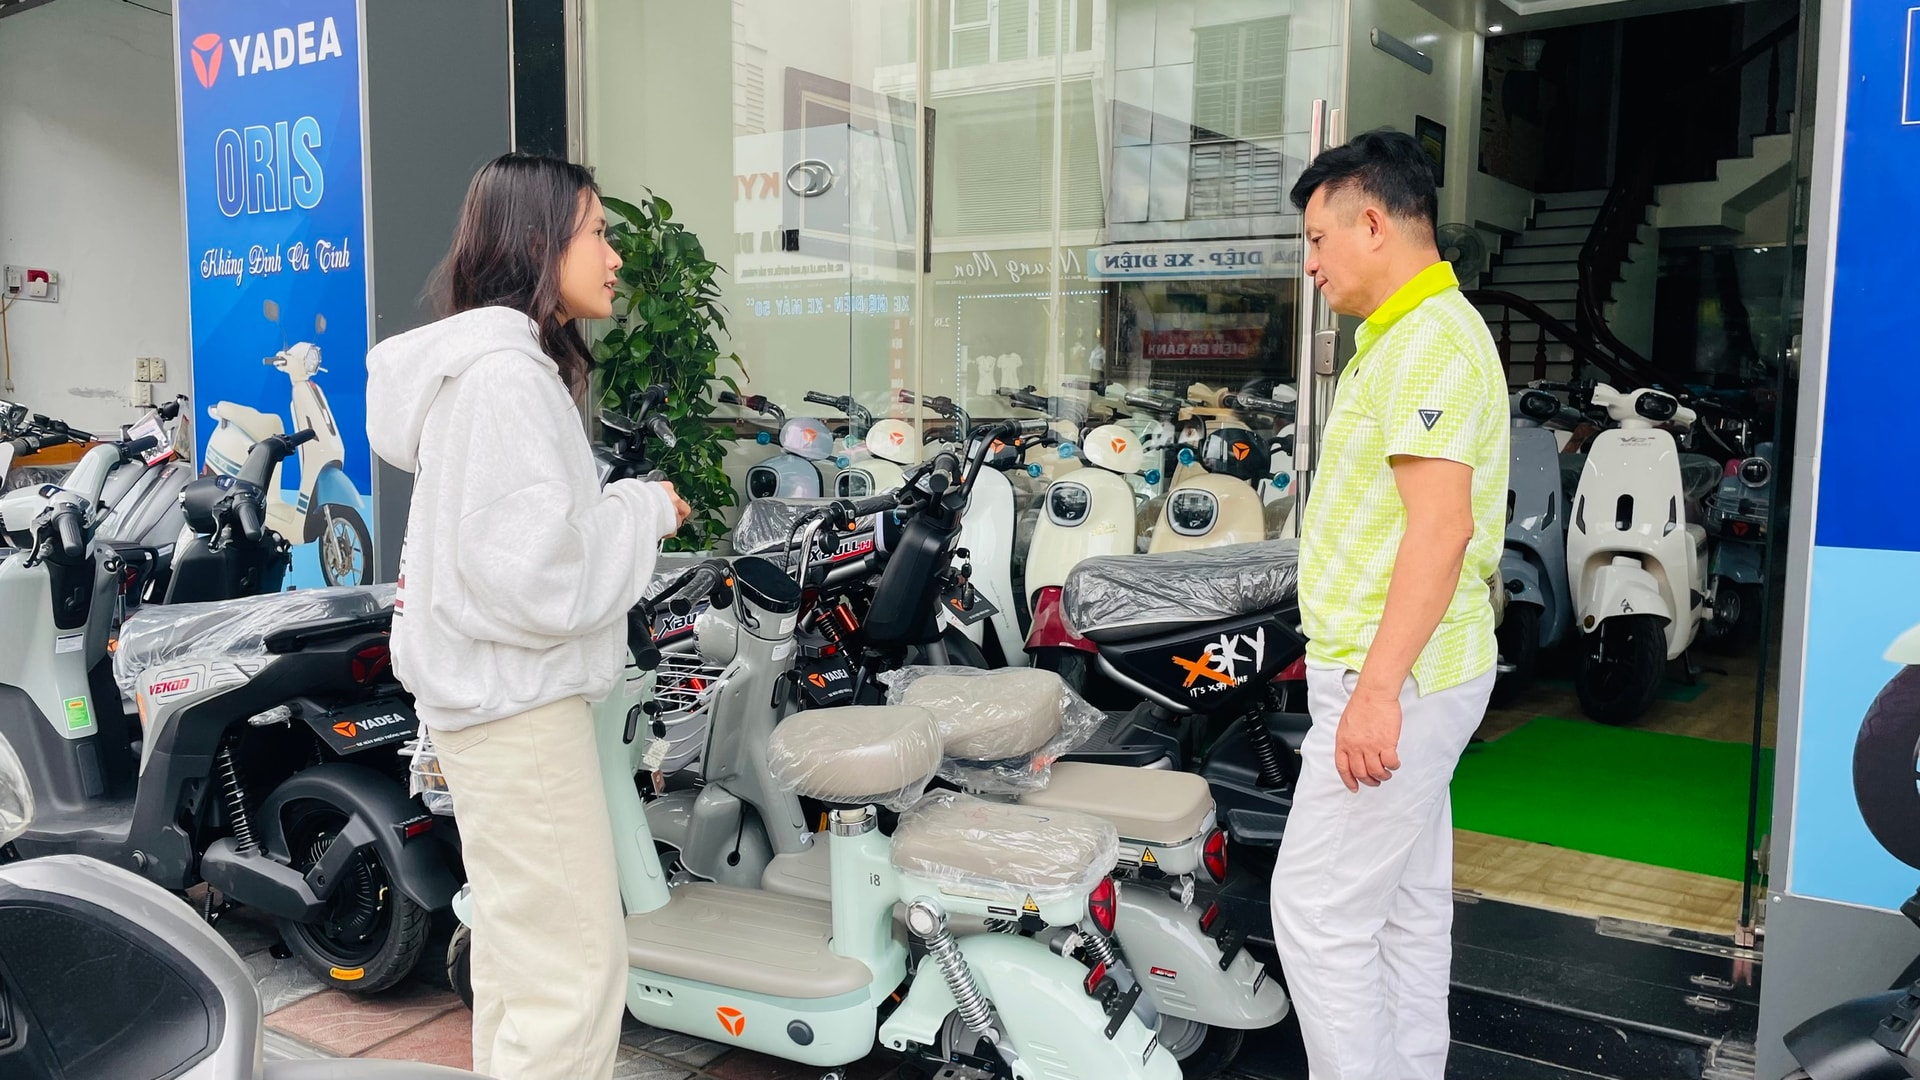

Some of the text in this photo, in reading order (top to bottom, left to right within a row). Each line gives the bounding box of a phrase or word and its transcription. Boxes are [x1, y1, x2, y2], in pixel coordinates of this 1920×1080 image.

[229, 17, 343, 77] YADEA
[215, 116, 324, 217] ORIS
[249, 243, 282, 278] Định
[287, 241, 310, 272] Cá
[315, 237, 350, 273] Tính
[1190, 686, 1205, 698] IT'S
[355, 713, 406, 730] YADEA
[869, 872, 881, 887] i8
